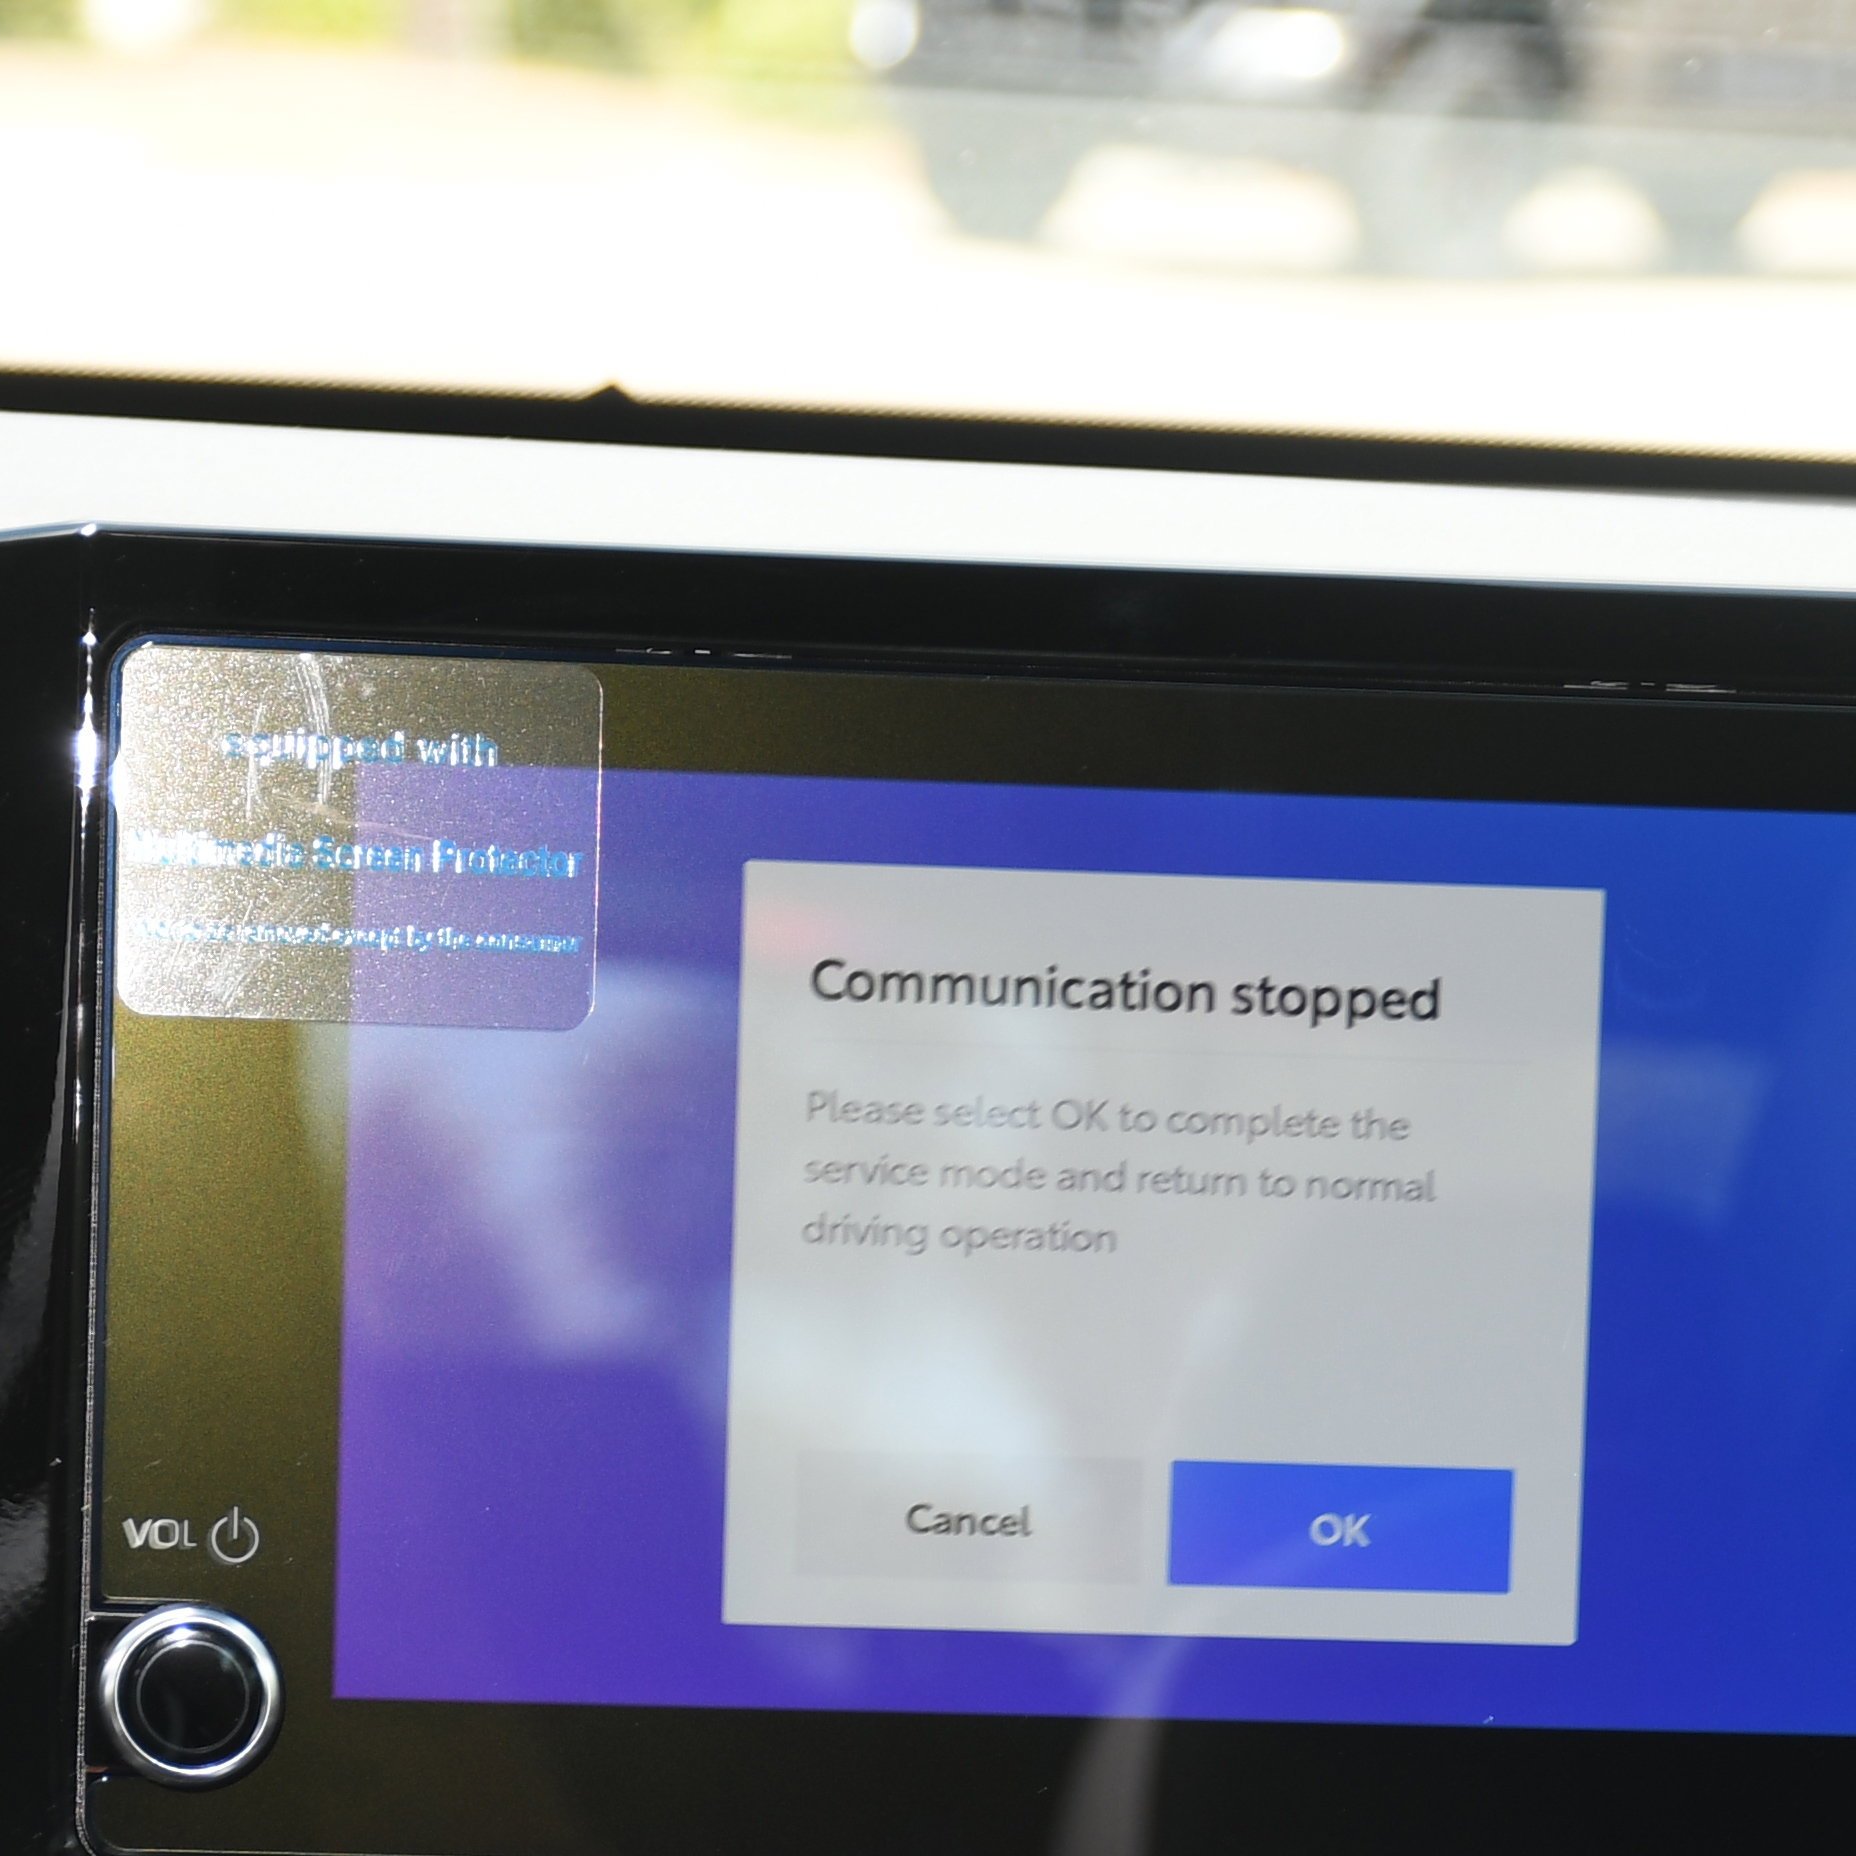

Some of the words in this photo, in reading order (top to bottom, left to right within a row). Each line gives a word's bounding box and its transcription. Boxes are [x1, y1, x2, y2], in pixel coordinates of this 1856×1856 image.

[417, 732, 498, 767] with
[313, 834, 422, 872] Screen
[433, 838, 585, 878] Protector
[811, 957, 1215, 1014] Communication
[1231, 975, 1441, 1029] stopped
[805, 1089, 925, 1128] Please
[934, 1092, 1041, 1131] select
[1050, 1098, 1110, 1133] OK
[1118, 1102, 1157, 1135] to
[1166, 1099, 1341, 1145] complete
[1350, 1105, 1411, 1142] the
[802, 1152, 929, 1188] service
[940, 1156, 1047, 1191] mode
[1056, 1160, 1125, 1195] and
[1135, 1167, 1248, 1199] return
[1257, 1167, 1296, 1201] to
[1305, 1169, 1438, 1204] normal
[801, 1213, 929, 1257] driving
[939, 1216, 1118, 1255] operation
[121, 1517, 198, 1550] VOL
[905, 1503, 1033, 1539] Cancel
[1309, 1512, 1373, 1548] OK
